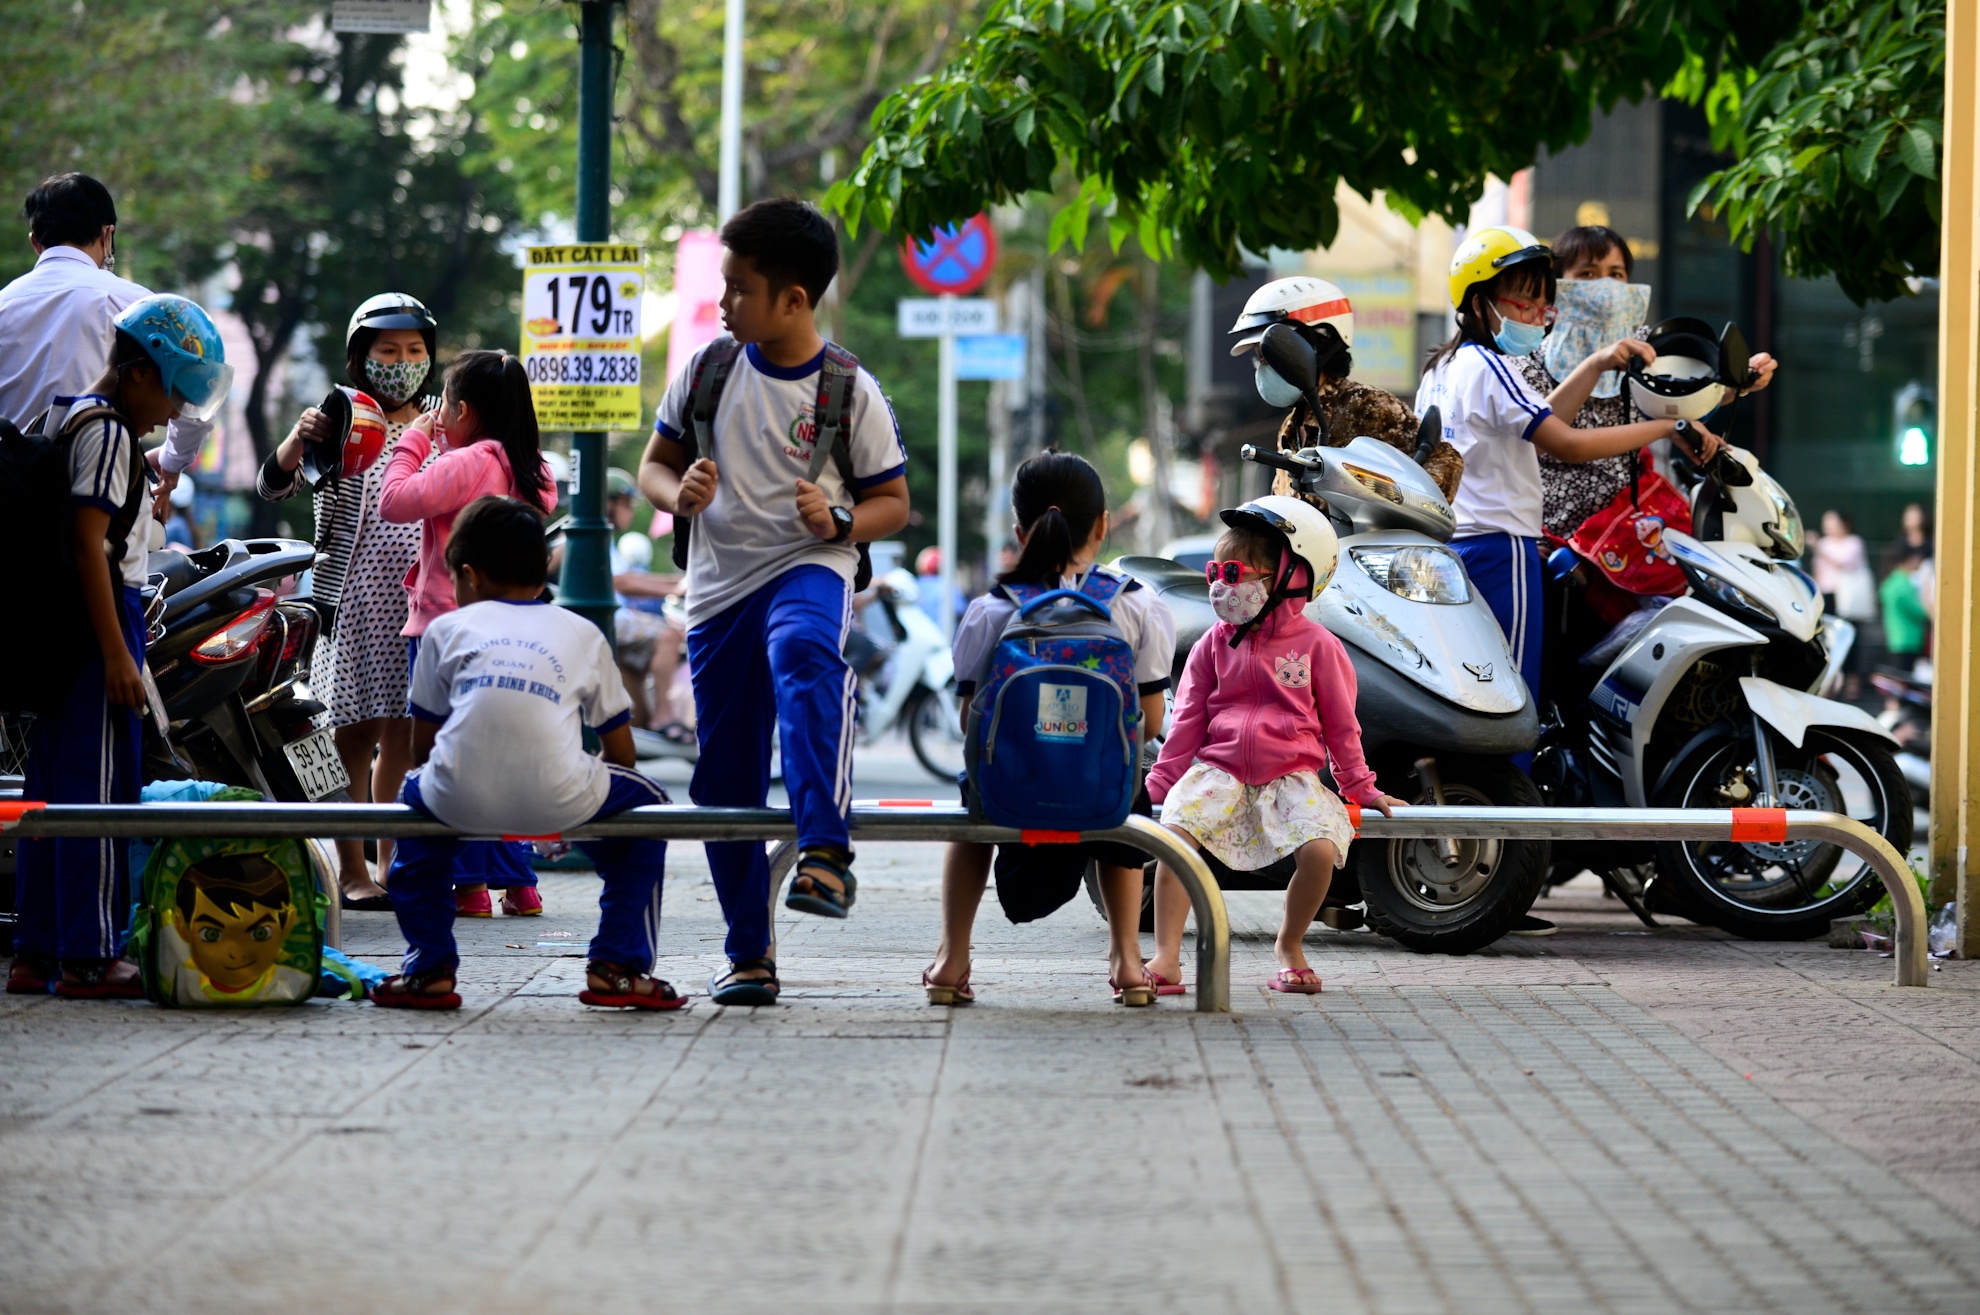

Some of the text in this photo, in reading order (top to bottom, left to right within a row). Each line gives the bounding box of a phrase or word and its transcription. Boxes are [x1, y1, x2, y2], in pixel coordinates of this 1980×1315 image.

[547, 275, 633, 336] 179 TR
[527, 356, 638, 383] 0898.39.2838
[302, 758, 346, 797] 447.65
